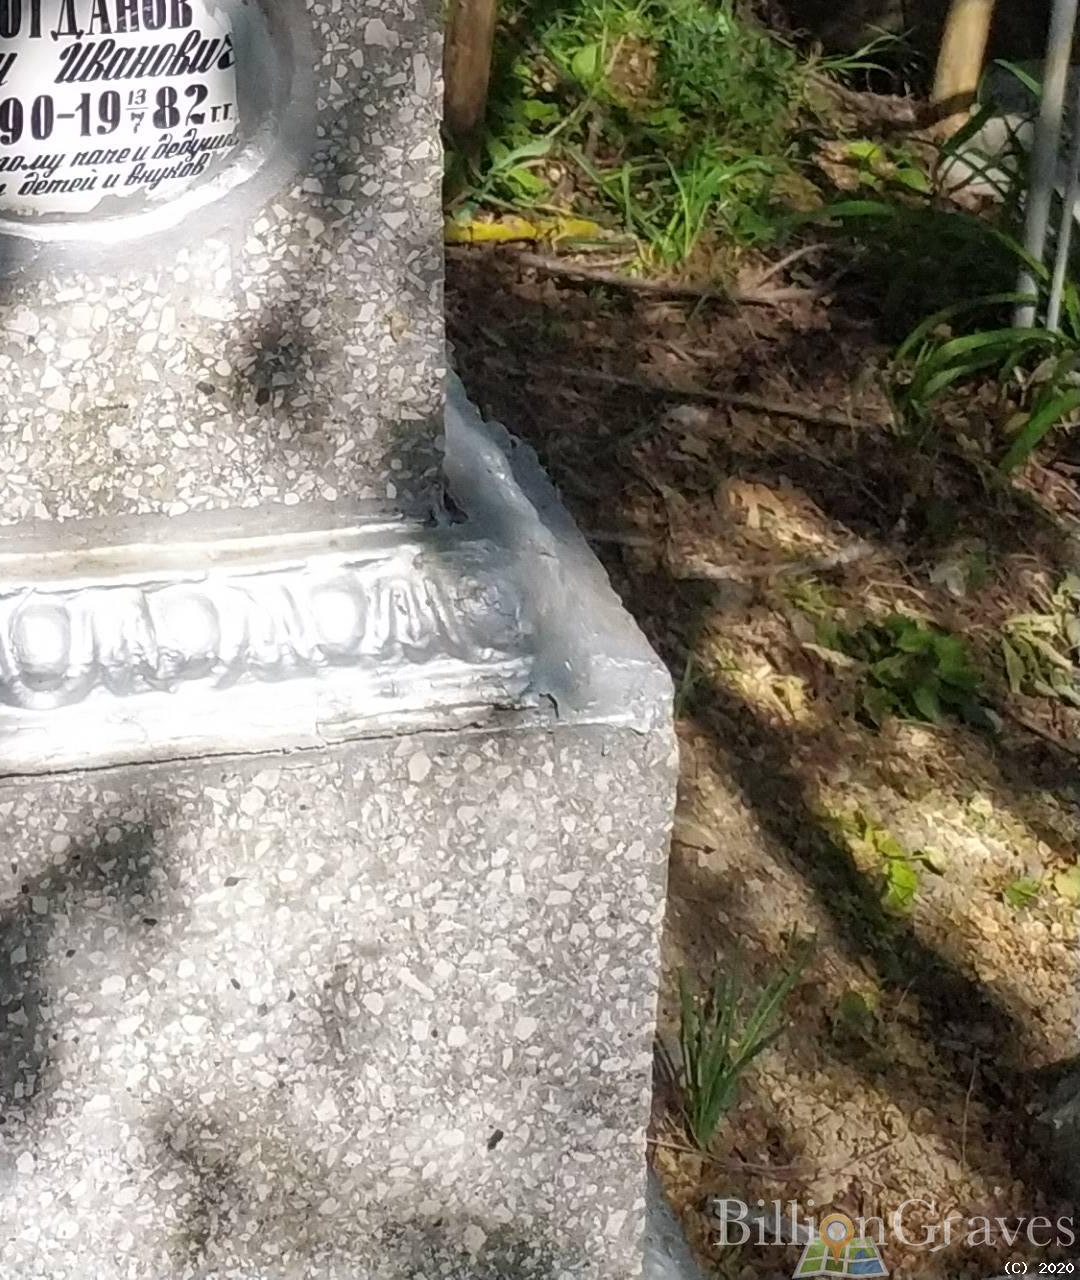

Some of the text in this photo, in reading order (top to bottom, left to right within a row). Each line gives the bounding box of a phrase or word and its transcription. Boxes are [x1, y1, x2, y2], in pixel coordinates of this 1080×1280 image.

[54, 30, 237, 83] Иванович
[18, 169, 97, 195] детей
[102, 174, 121, 188] и
[124, 153, 210, 190] внуков
[70, 148, 131, 168] папе
[132, 146, 150, 161] и
